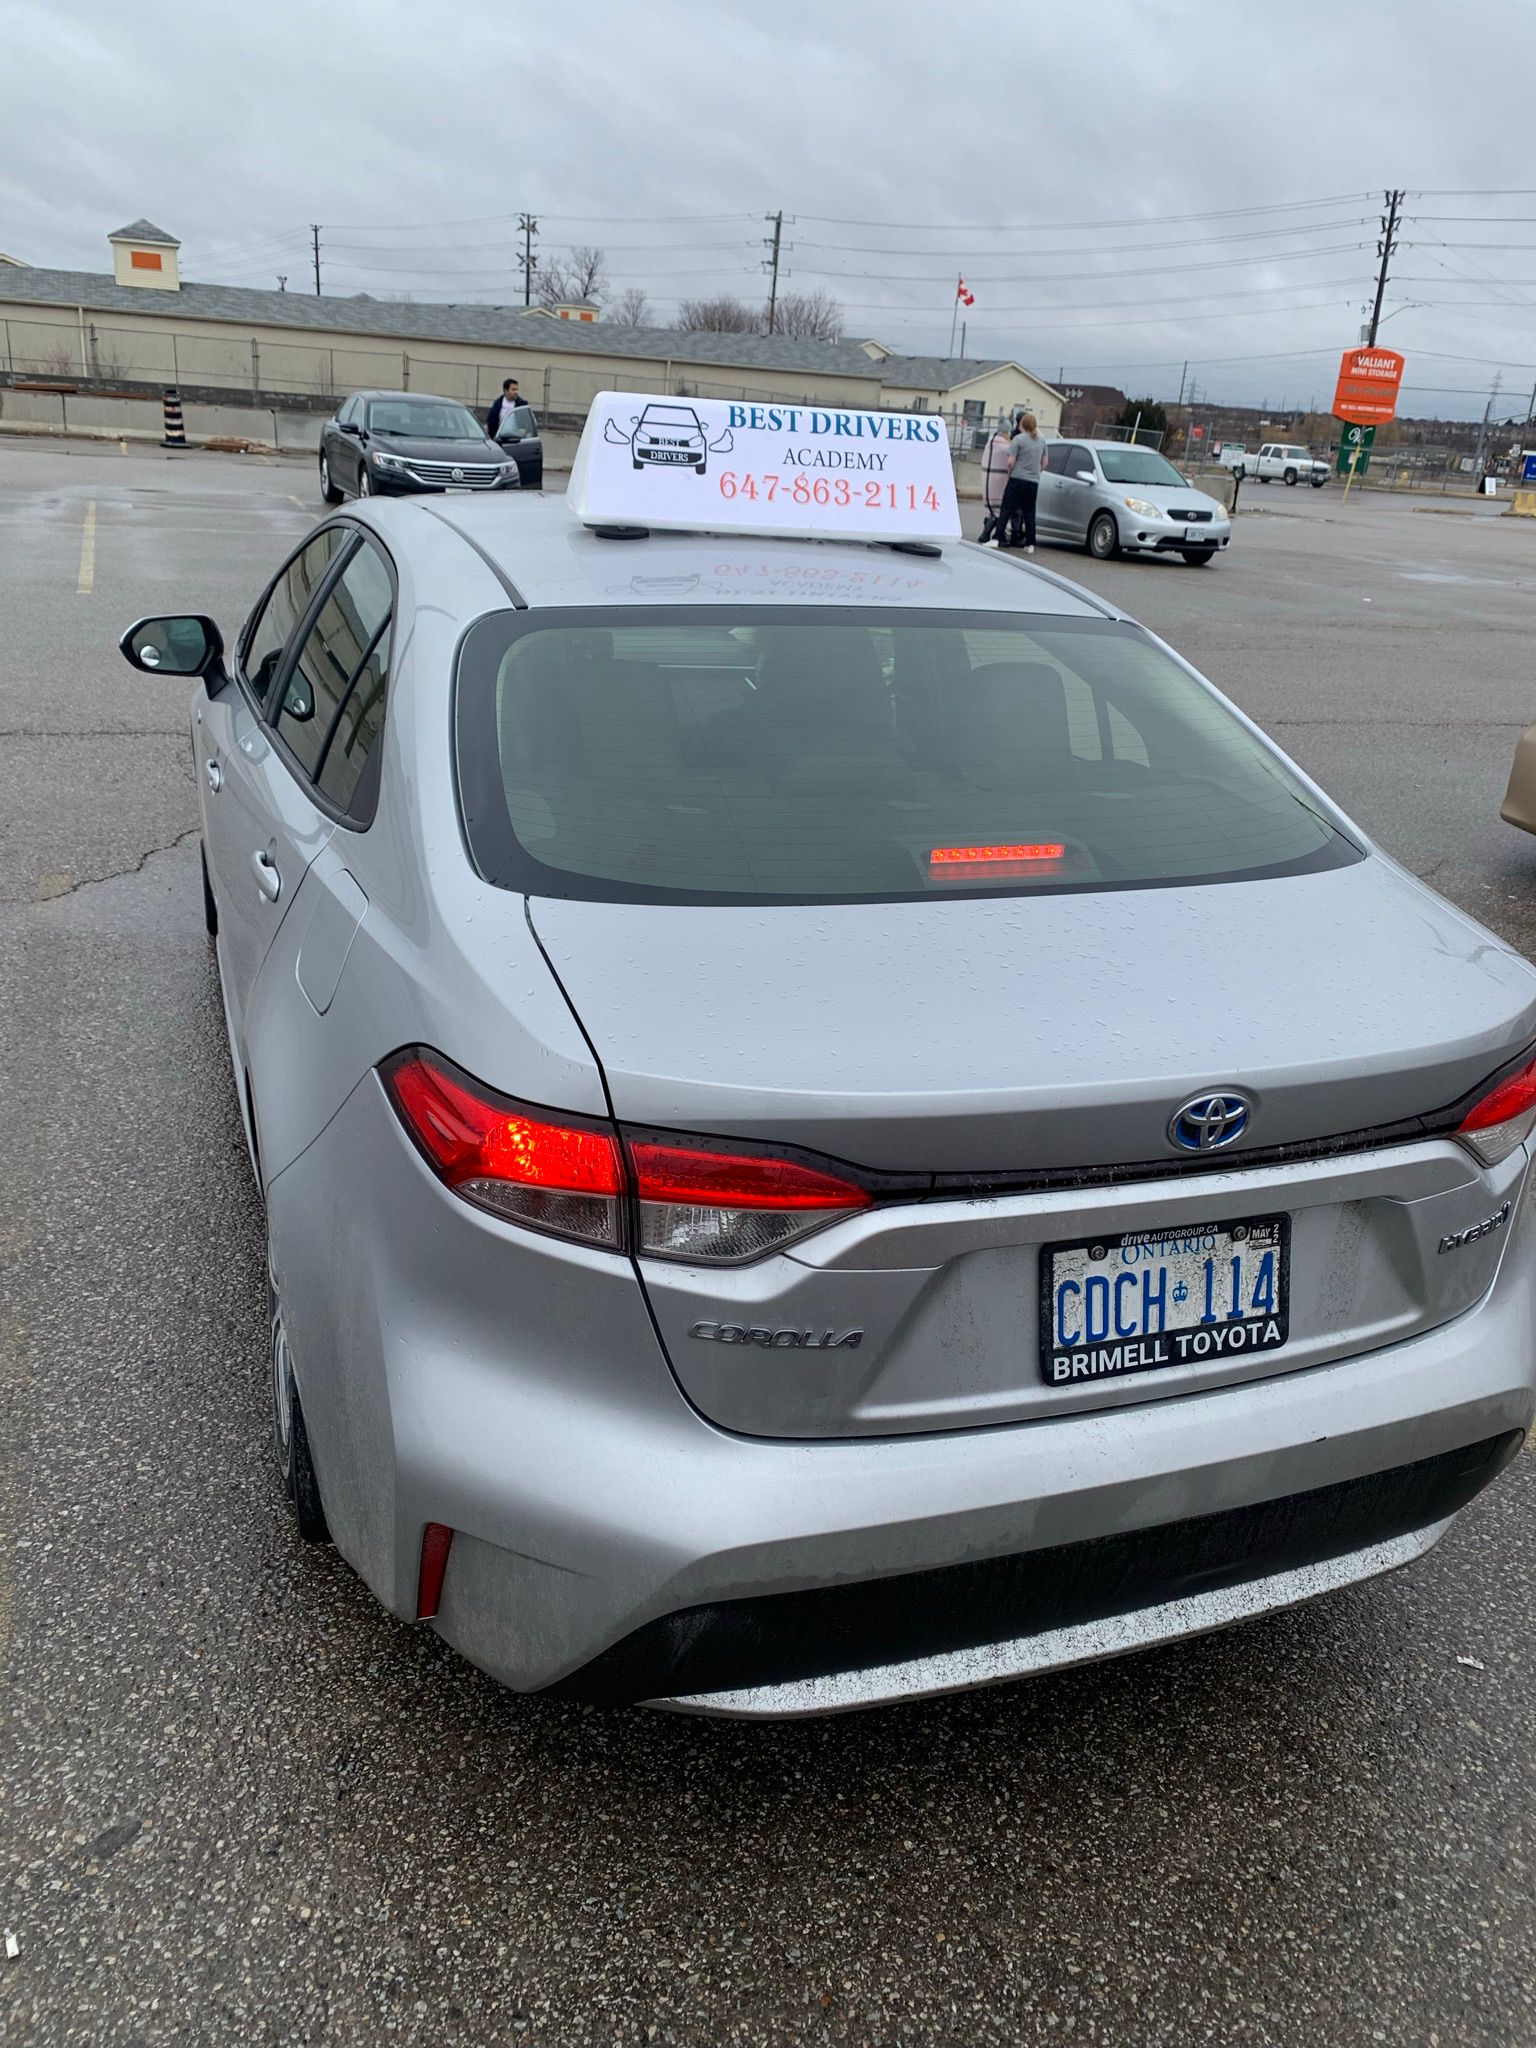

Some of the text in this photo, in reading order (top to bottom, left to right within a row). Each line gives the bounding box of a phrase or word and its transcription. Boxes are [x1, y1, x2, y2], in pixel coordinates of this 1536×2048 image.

[1351, 367, 1398, 378] MINI STORAGE
[1358, 356, 1396, 369] VALIANT
[728, 405, 941, 442] BEST DRIVERS
[650, 450, 689, 462] DRIVERS
[659, 437, 681, 447] BEST
[782, 447, 888, 472] ACADEMY
[719, 470, 941, 512] 647-863-2114
[1252, 1227, 1271, 1239] MAY
[1438, 1200, 1511, 1255] HYBRID
[1121, 1234, 1216, 1265] ONTARIO
[1058, 1250, 1275, 1347] CDCH 114
[688, 1320, 865, 1350] COROLLA
[1053, 1320, 1281, 1381] BRIMELL TOYOTA
